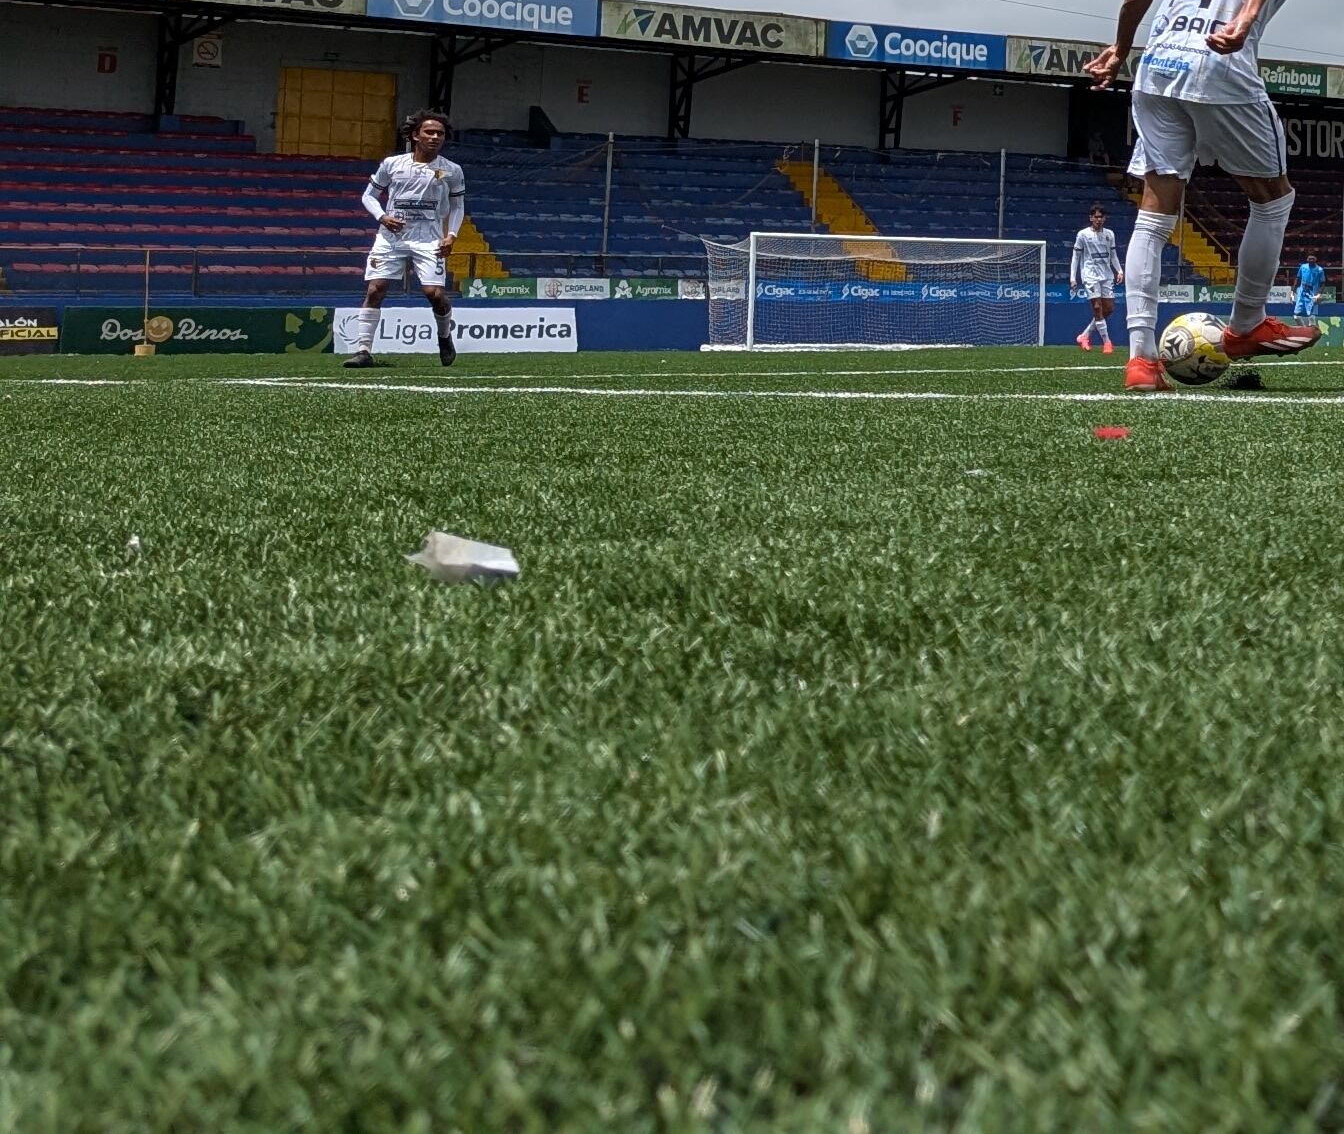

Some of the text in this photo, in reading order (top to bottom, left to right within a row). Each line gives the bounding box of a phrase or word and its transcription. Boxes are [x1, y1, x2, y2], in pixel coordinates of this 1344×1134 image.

[653, 12, 784, 48] AMVAC
[884, 32, 988, 66] Coocique
[1260, 66, 1321, 86] Rainbow
[490, 284, 531, 296] Agromix
[565, 284, 604, 293] CROPLAND
[635, 285, 672, 297] Agromix
[765, 284, 795, 298] Cigac
[851, 285, 880, 299] Cigac
[0, 329, 57, 338] FICIAL
[100, 318, 249, 341] Dos Pinos
[379, 319, 432, 346] Liga
